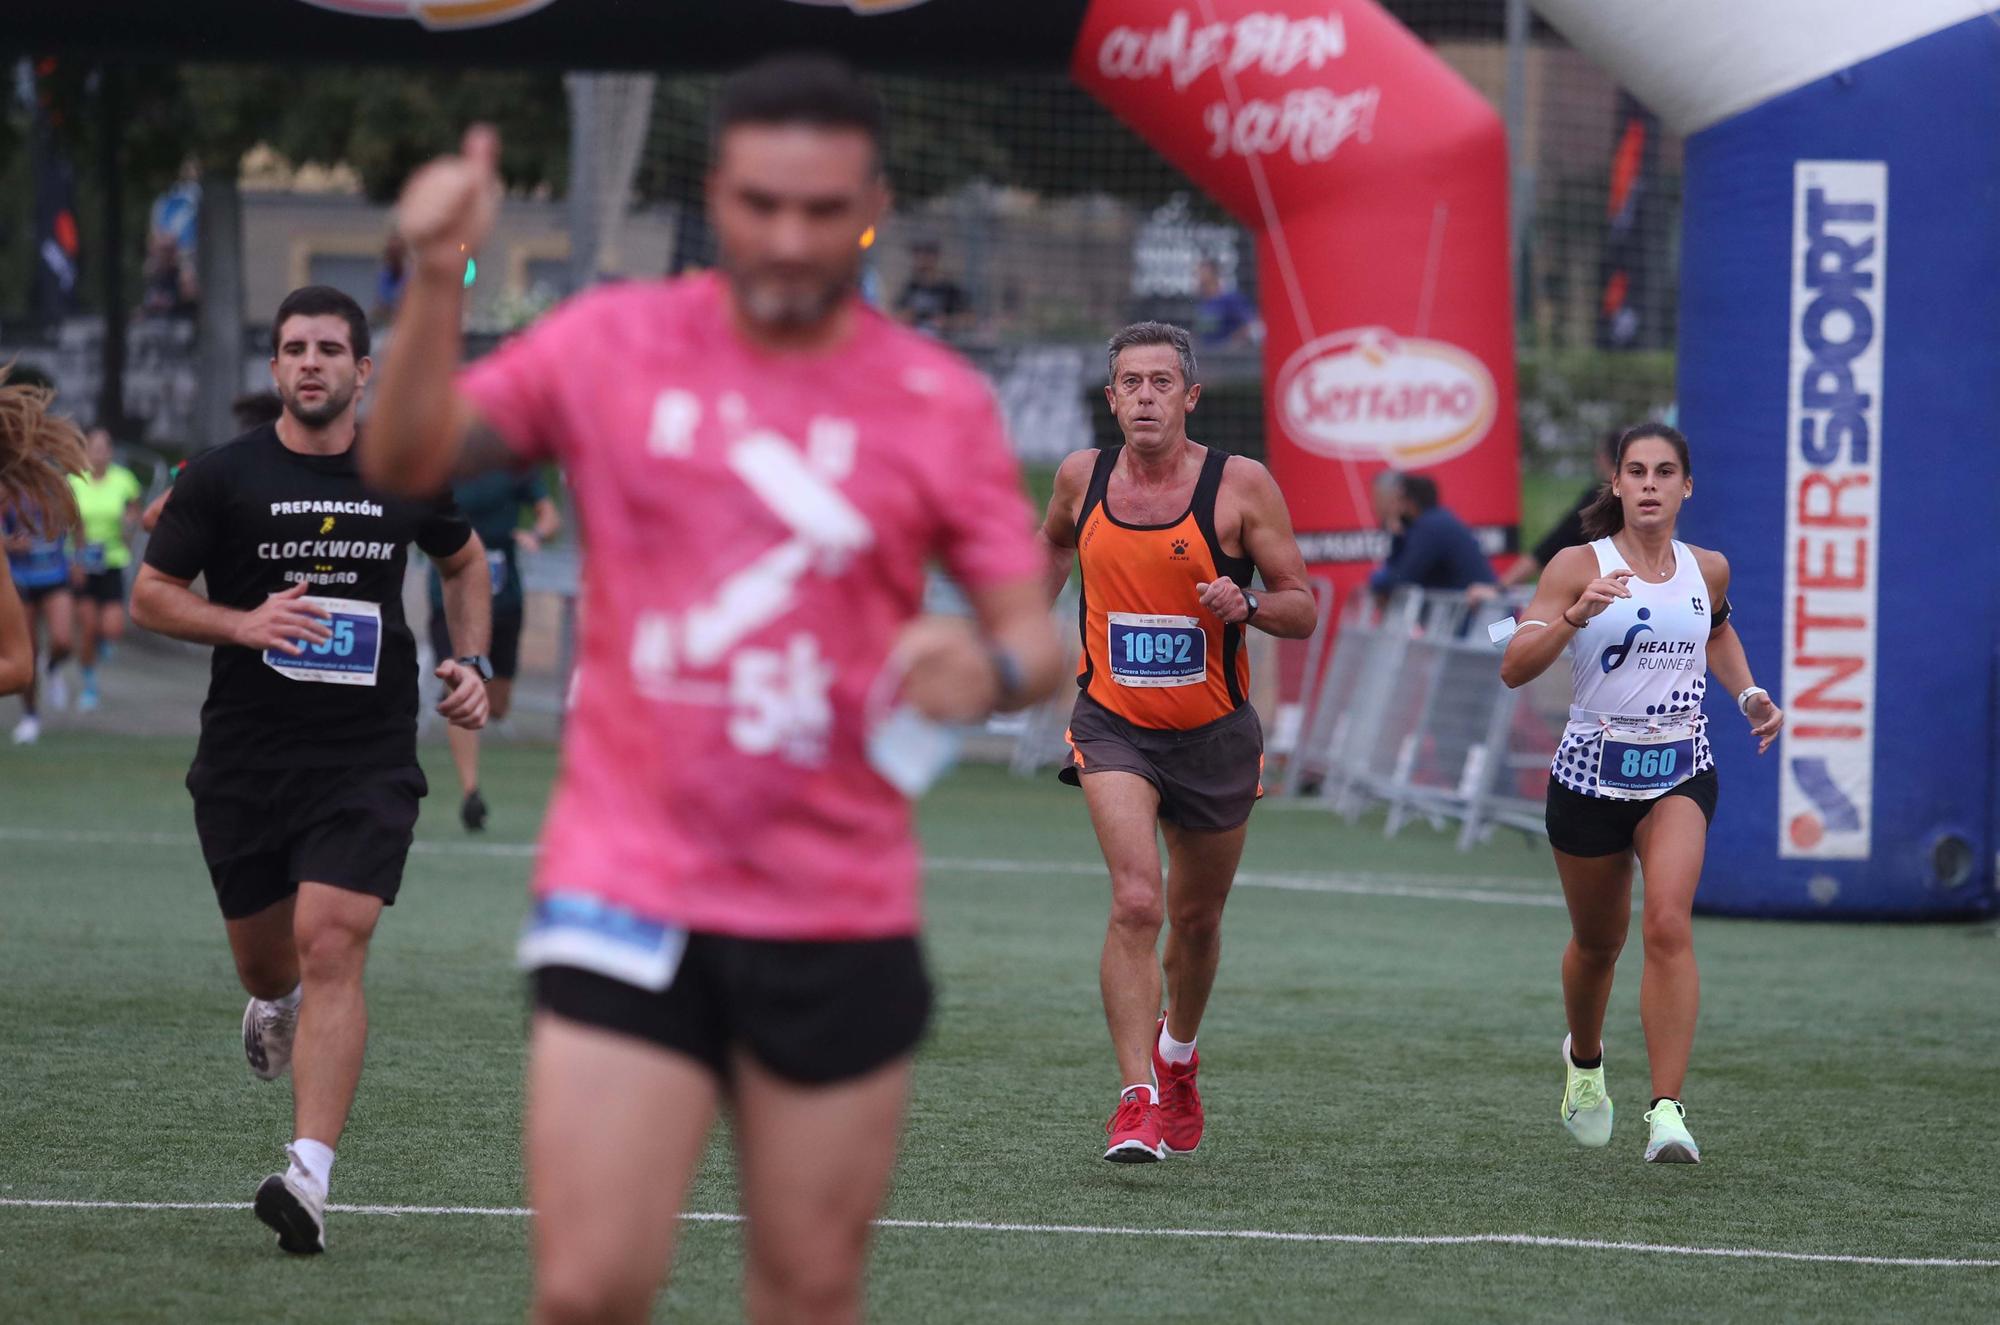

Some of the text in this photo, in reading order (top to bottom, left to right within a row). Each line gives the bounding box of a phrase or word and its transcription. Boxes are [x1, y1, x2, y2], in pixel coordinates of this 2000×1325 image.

[1302, 366, 1476, 424] Serrano
[1792, 187, 1878, 741] INTERSPORT
[270, 500, 383, 517] PREPARACIÓN
[257, 541, 395, 560] CLOCKWORK
[297, 618, 355, 656] 55
[1122, 632, 1192, 664] 1092
[1637, 641, 1696, 654] HEALTH
[1621, 748, 1677, 778] 860
